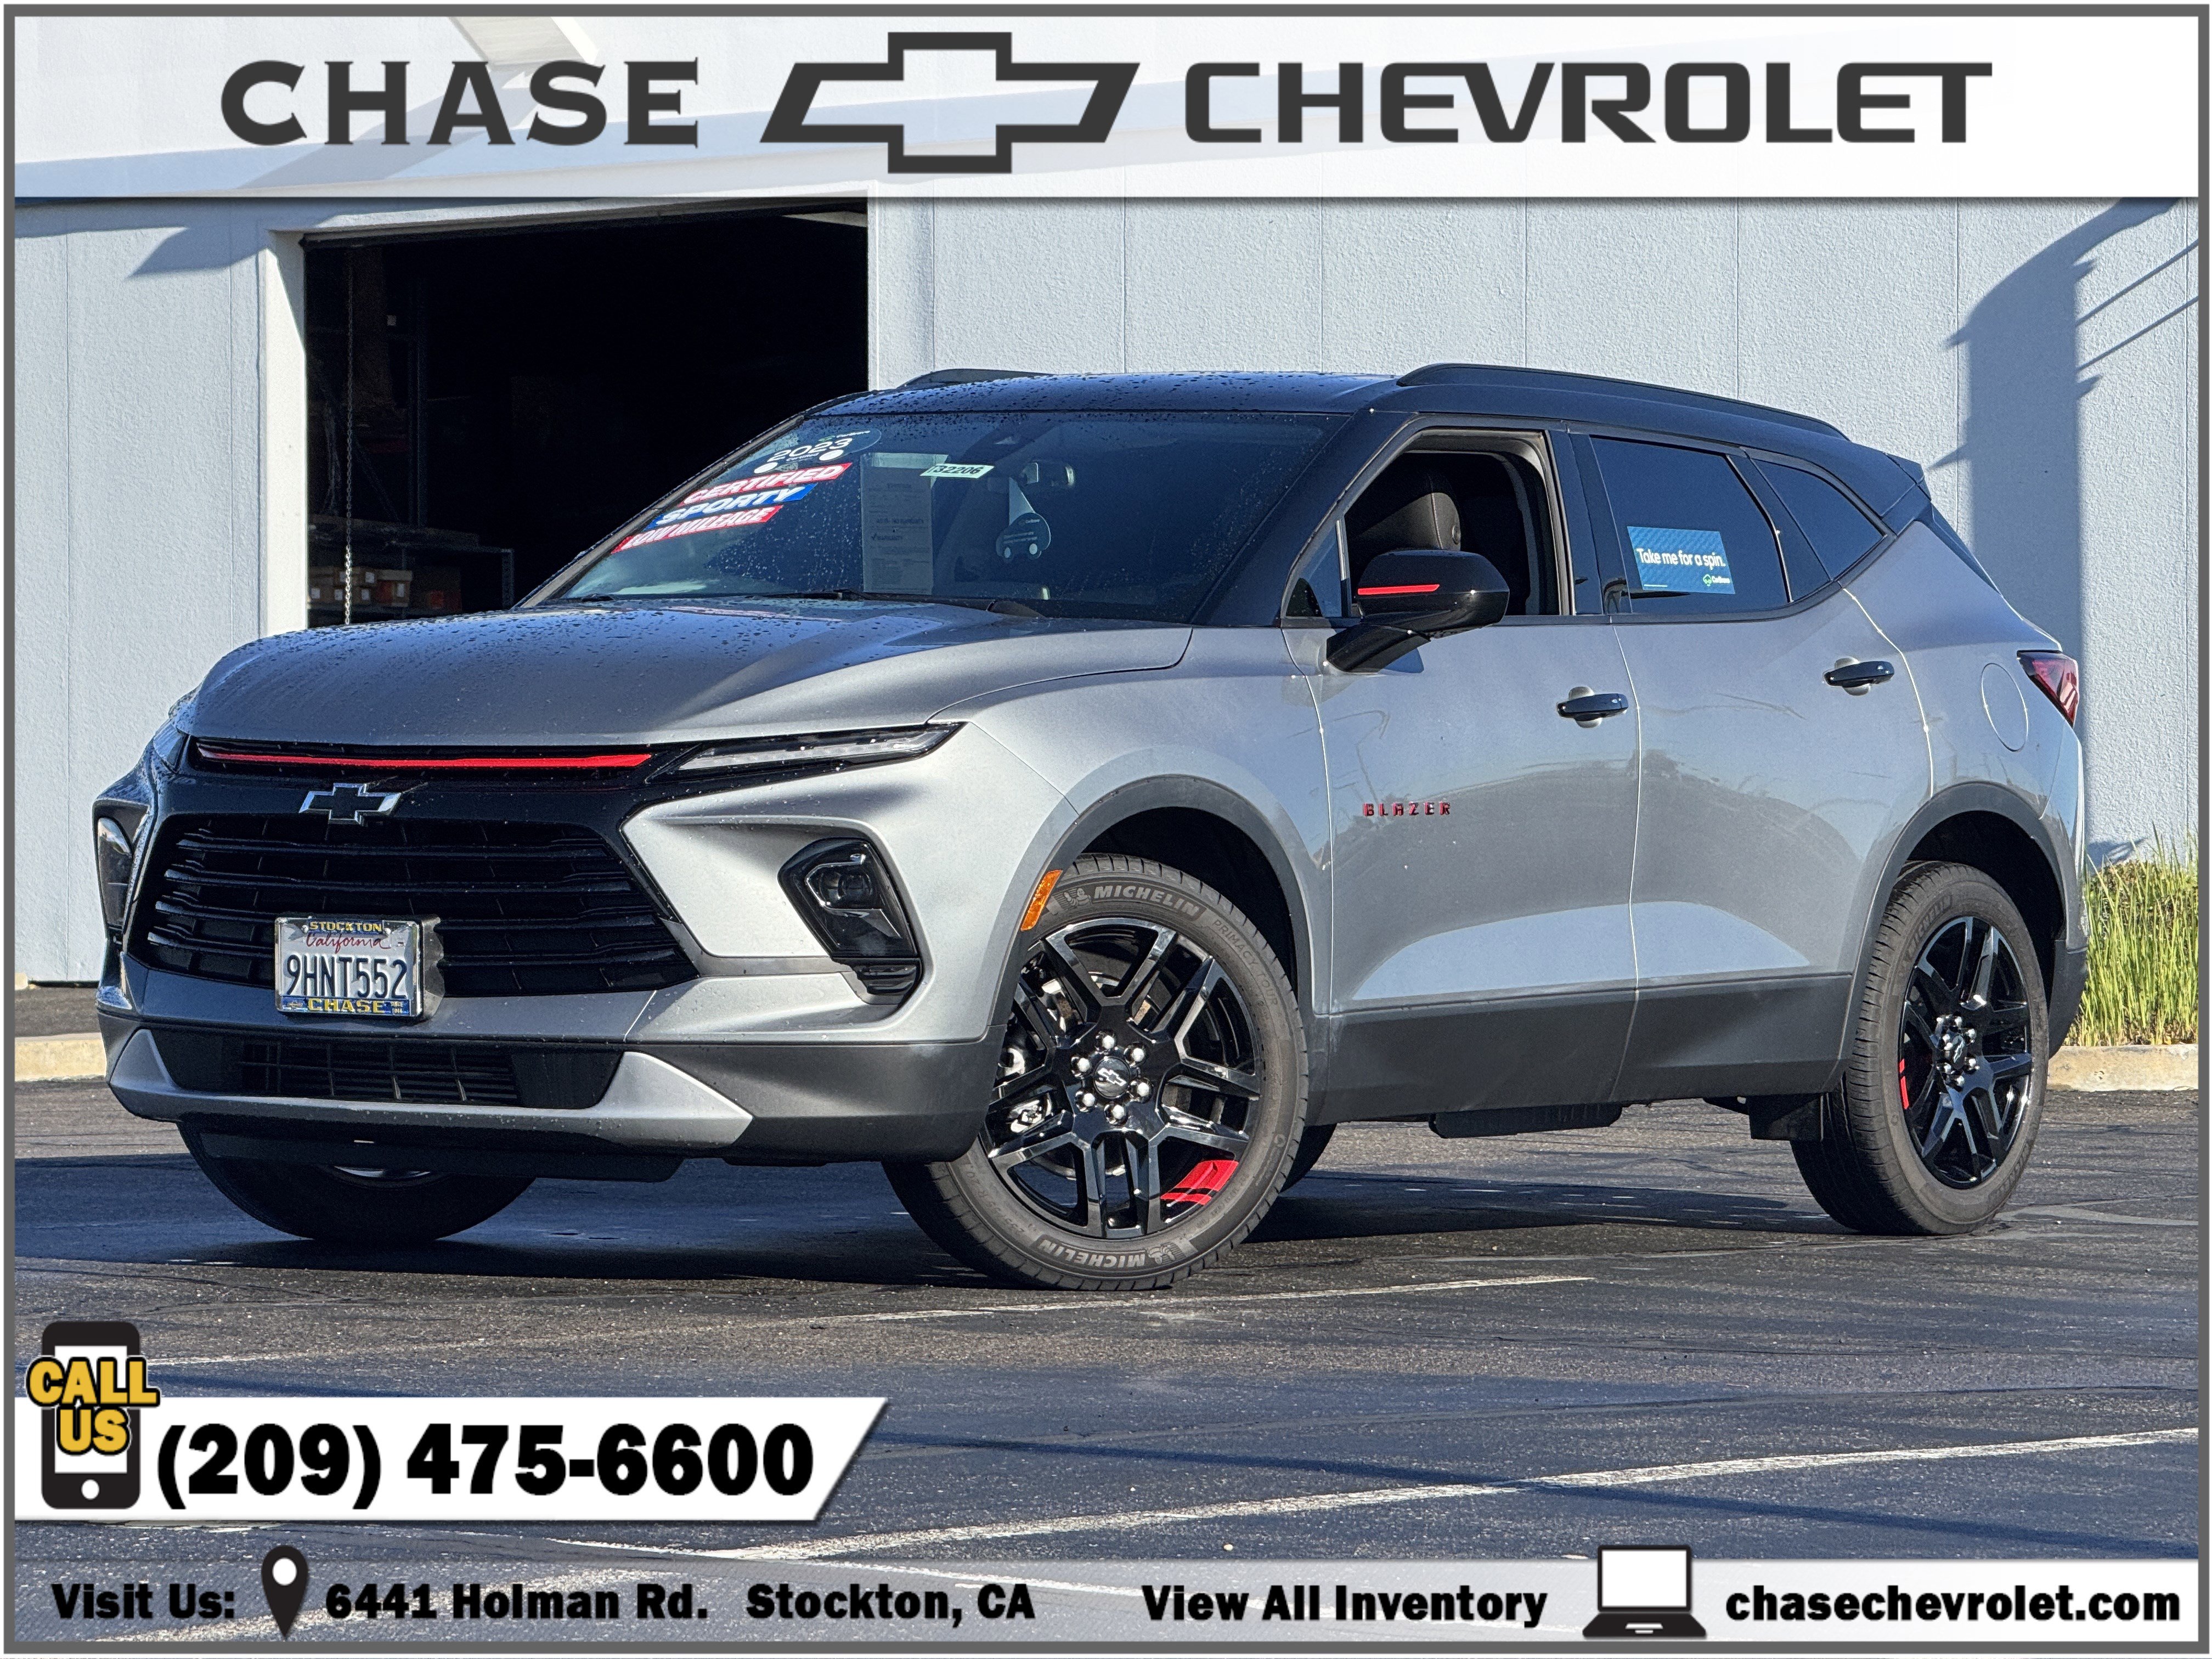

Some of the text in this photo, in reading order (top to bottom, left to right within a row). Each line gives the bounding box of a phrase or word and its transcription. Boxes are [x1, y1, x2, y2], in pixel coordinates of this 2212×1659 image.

[767, 438, 853, 462] 2023
[683, 465, 845, 505] CERTIFIED
[656, 486, 806, 524] SPORTY
[668, 506, 775, 537] MILEAGE
[1636, 548, 1726, 571] Take me for a spin.
[1363, 801, 1451, 816] BLAZER
[1093, 885, 1199, 917] MICHELIN
[309, 921, 382, 932] STOCKTON
[306, 933, 392, 954] California
[1212, 919, 1256, 966] PRIMACY
[286, 954, 408, 999] 9HNT552
[307, 998, 386, 1014] CHASE
[1038, 1239, 1146, 1269] MICHELIN
